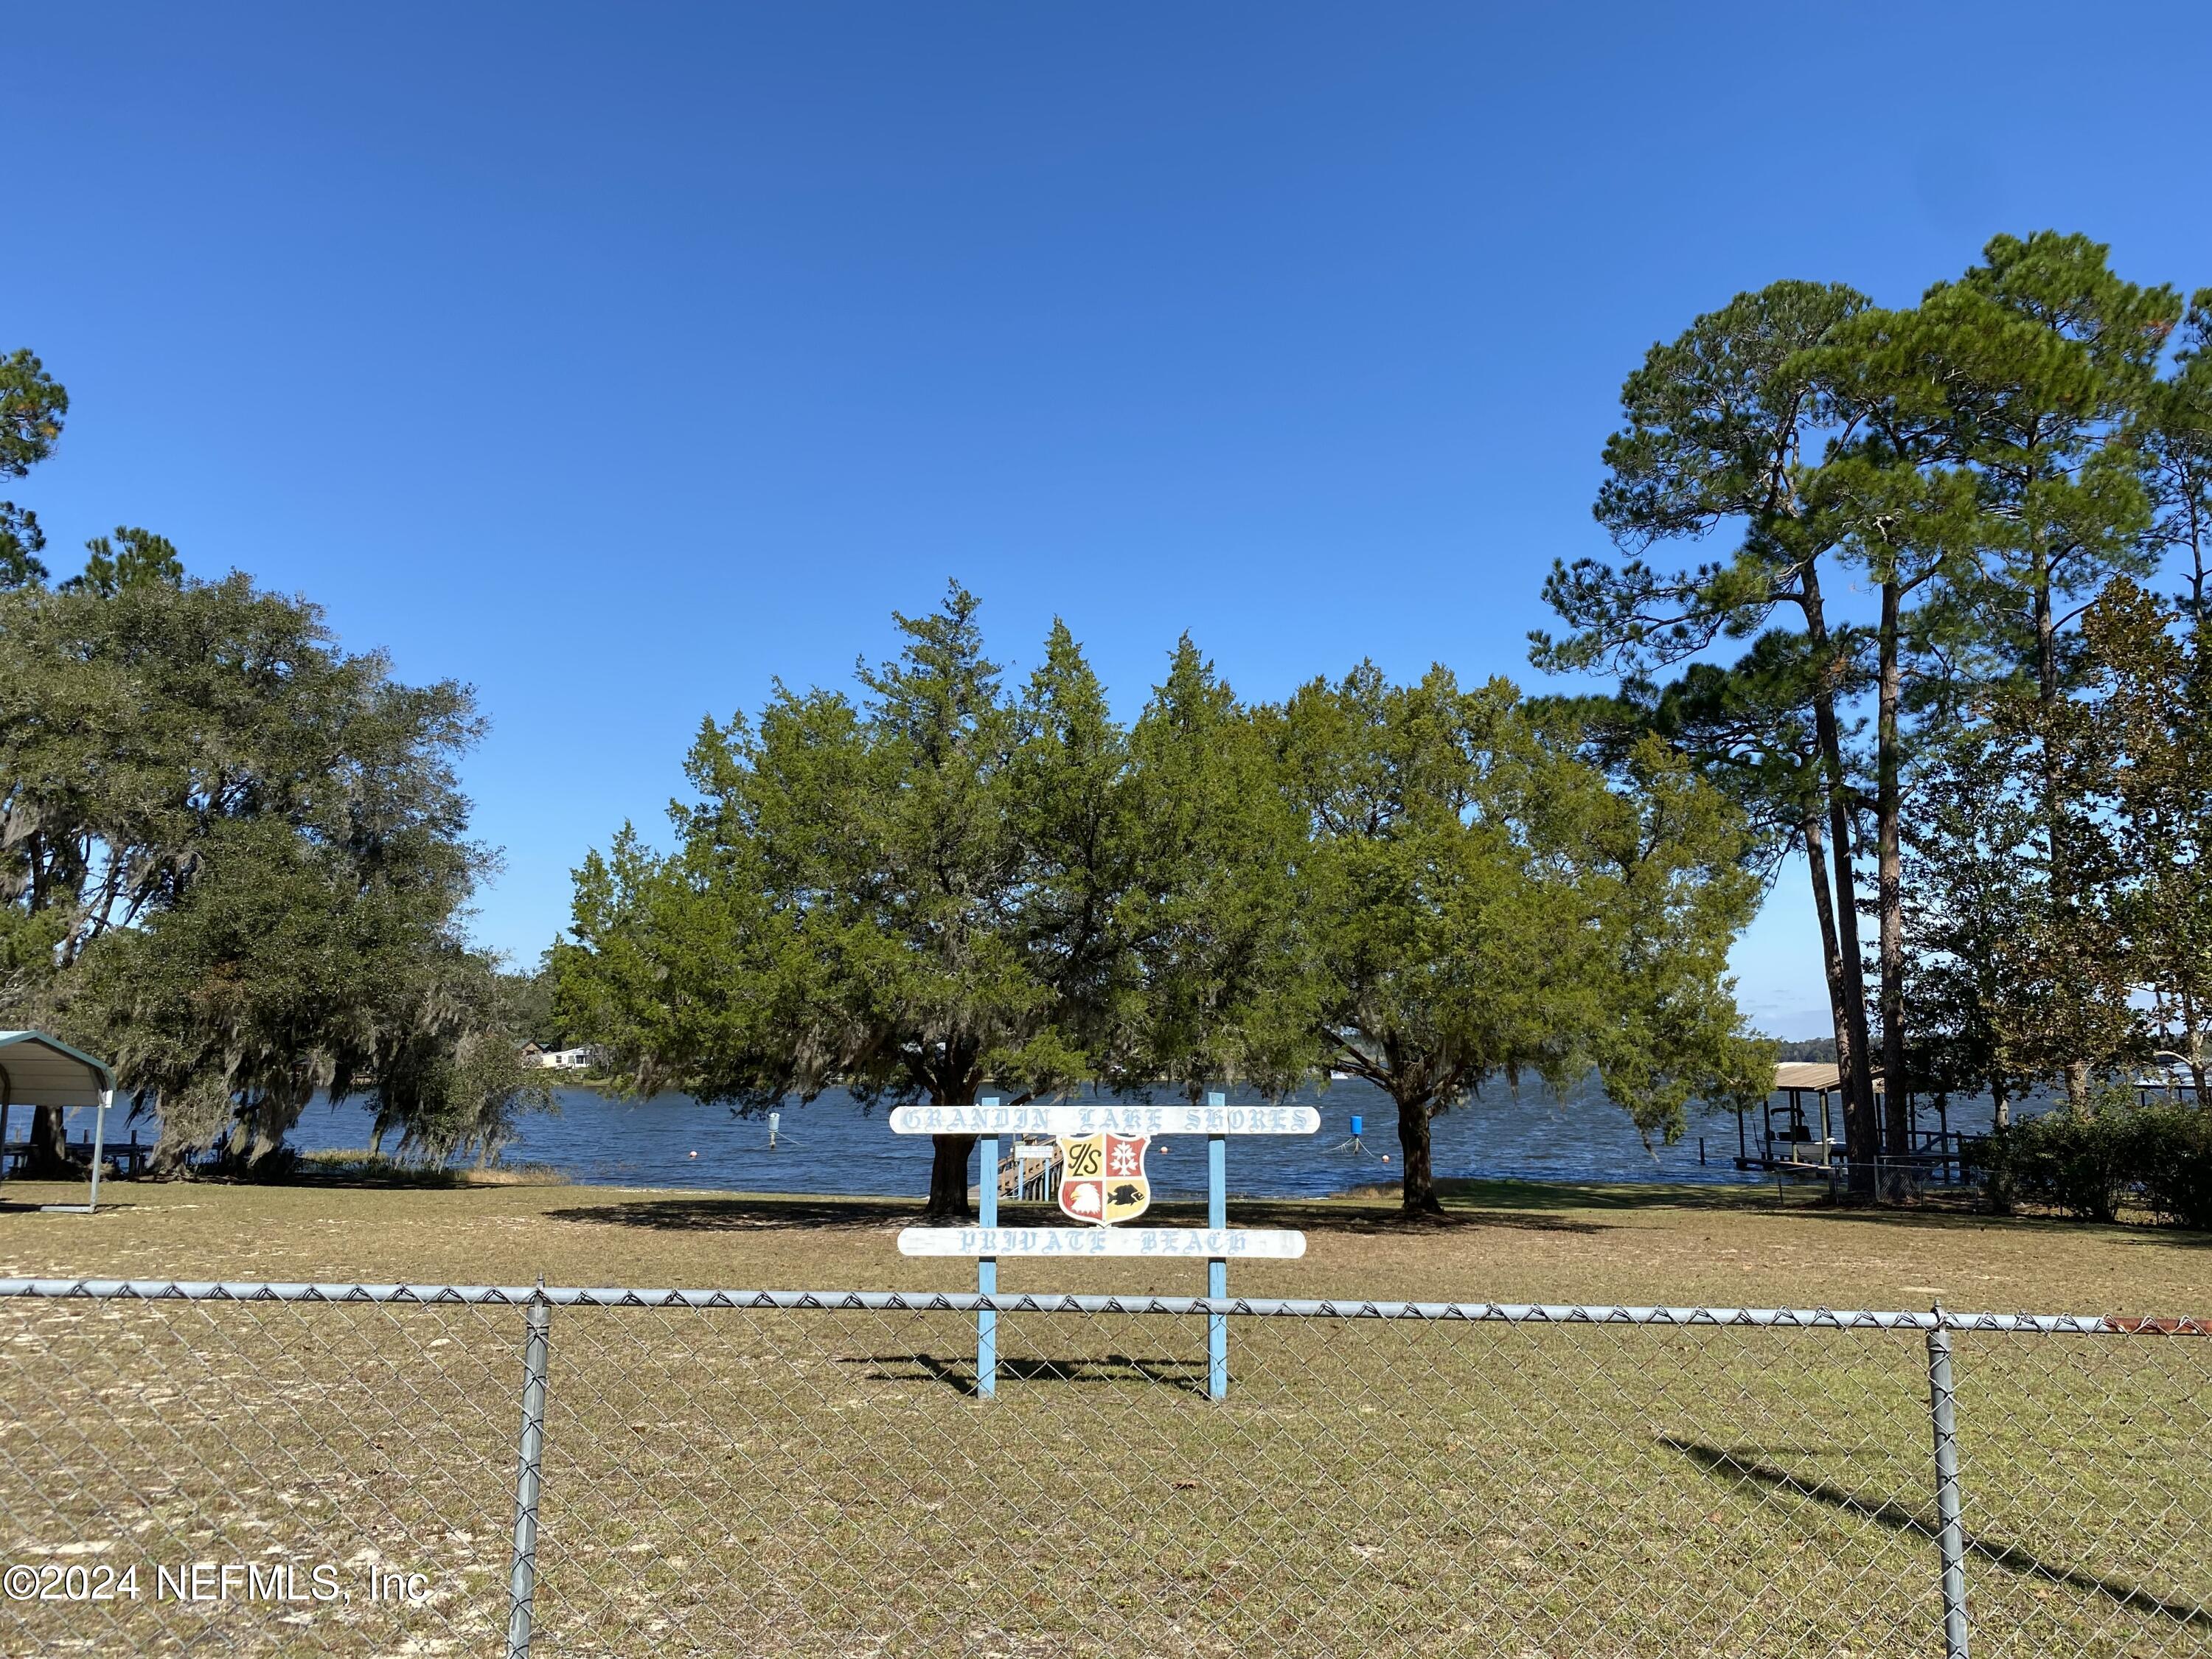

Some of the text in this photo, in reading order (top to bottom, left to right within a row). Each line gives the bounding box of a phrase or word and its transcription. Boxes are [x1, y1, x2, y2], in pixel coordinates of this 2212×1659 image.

[902, 1108, 1308, 1133] GRANDIN LAKE SHORES
[958, 1230, 1246, 1255] PRIVATE BEACH
